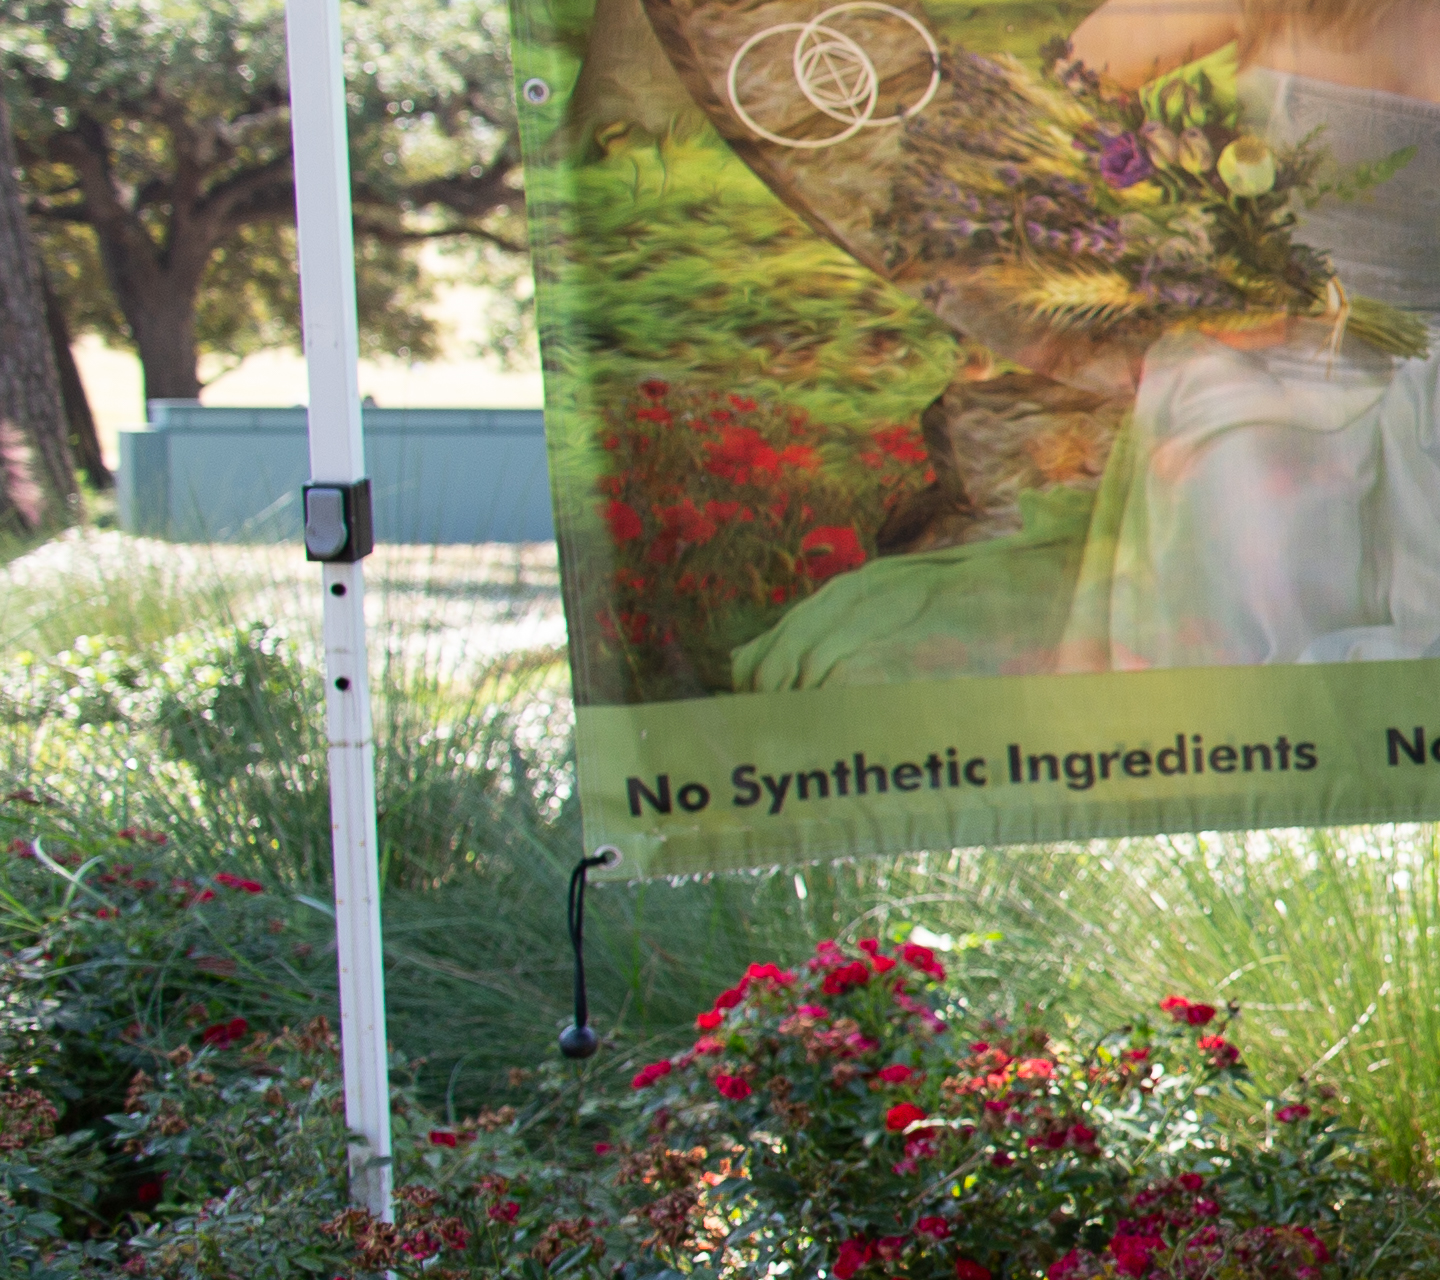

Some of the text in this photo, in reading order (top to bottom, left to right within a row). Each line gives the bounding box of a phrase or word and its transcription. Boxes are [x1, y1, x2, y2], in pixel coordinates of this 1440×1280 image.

[627, 773, 710, 818] No
[731, 748, 988, 816] Synthetic
[1007, 732, 1318, 791] Ingredients
